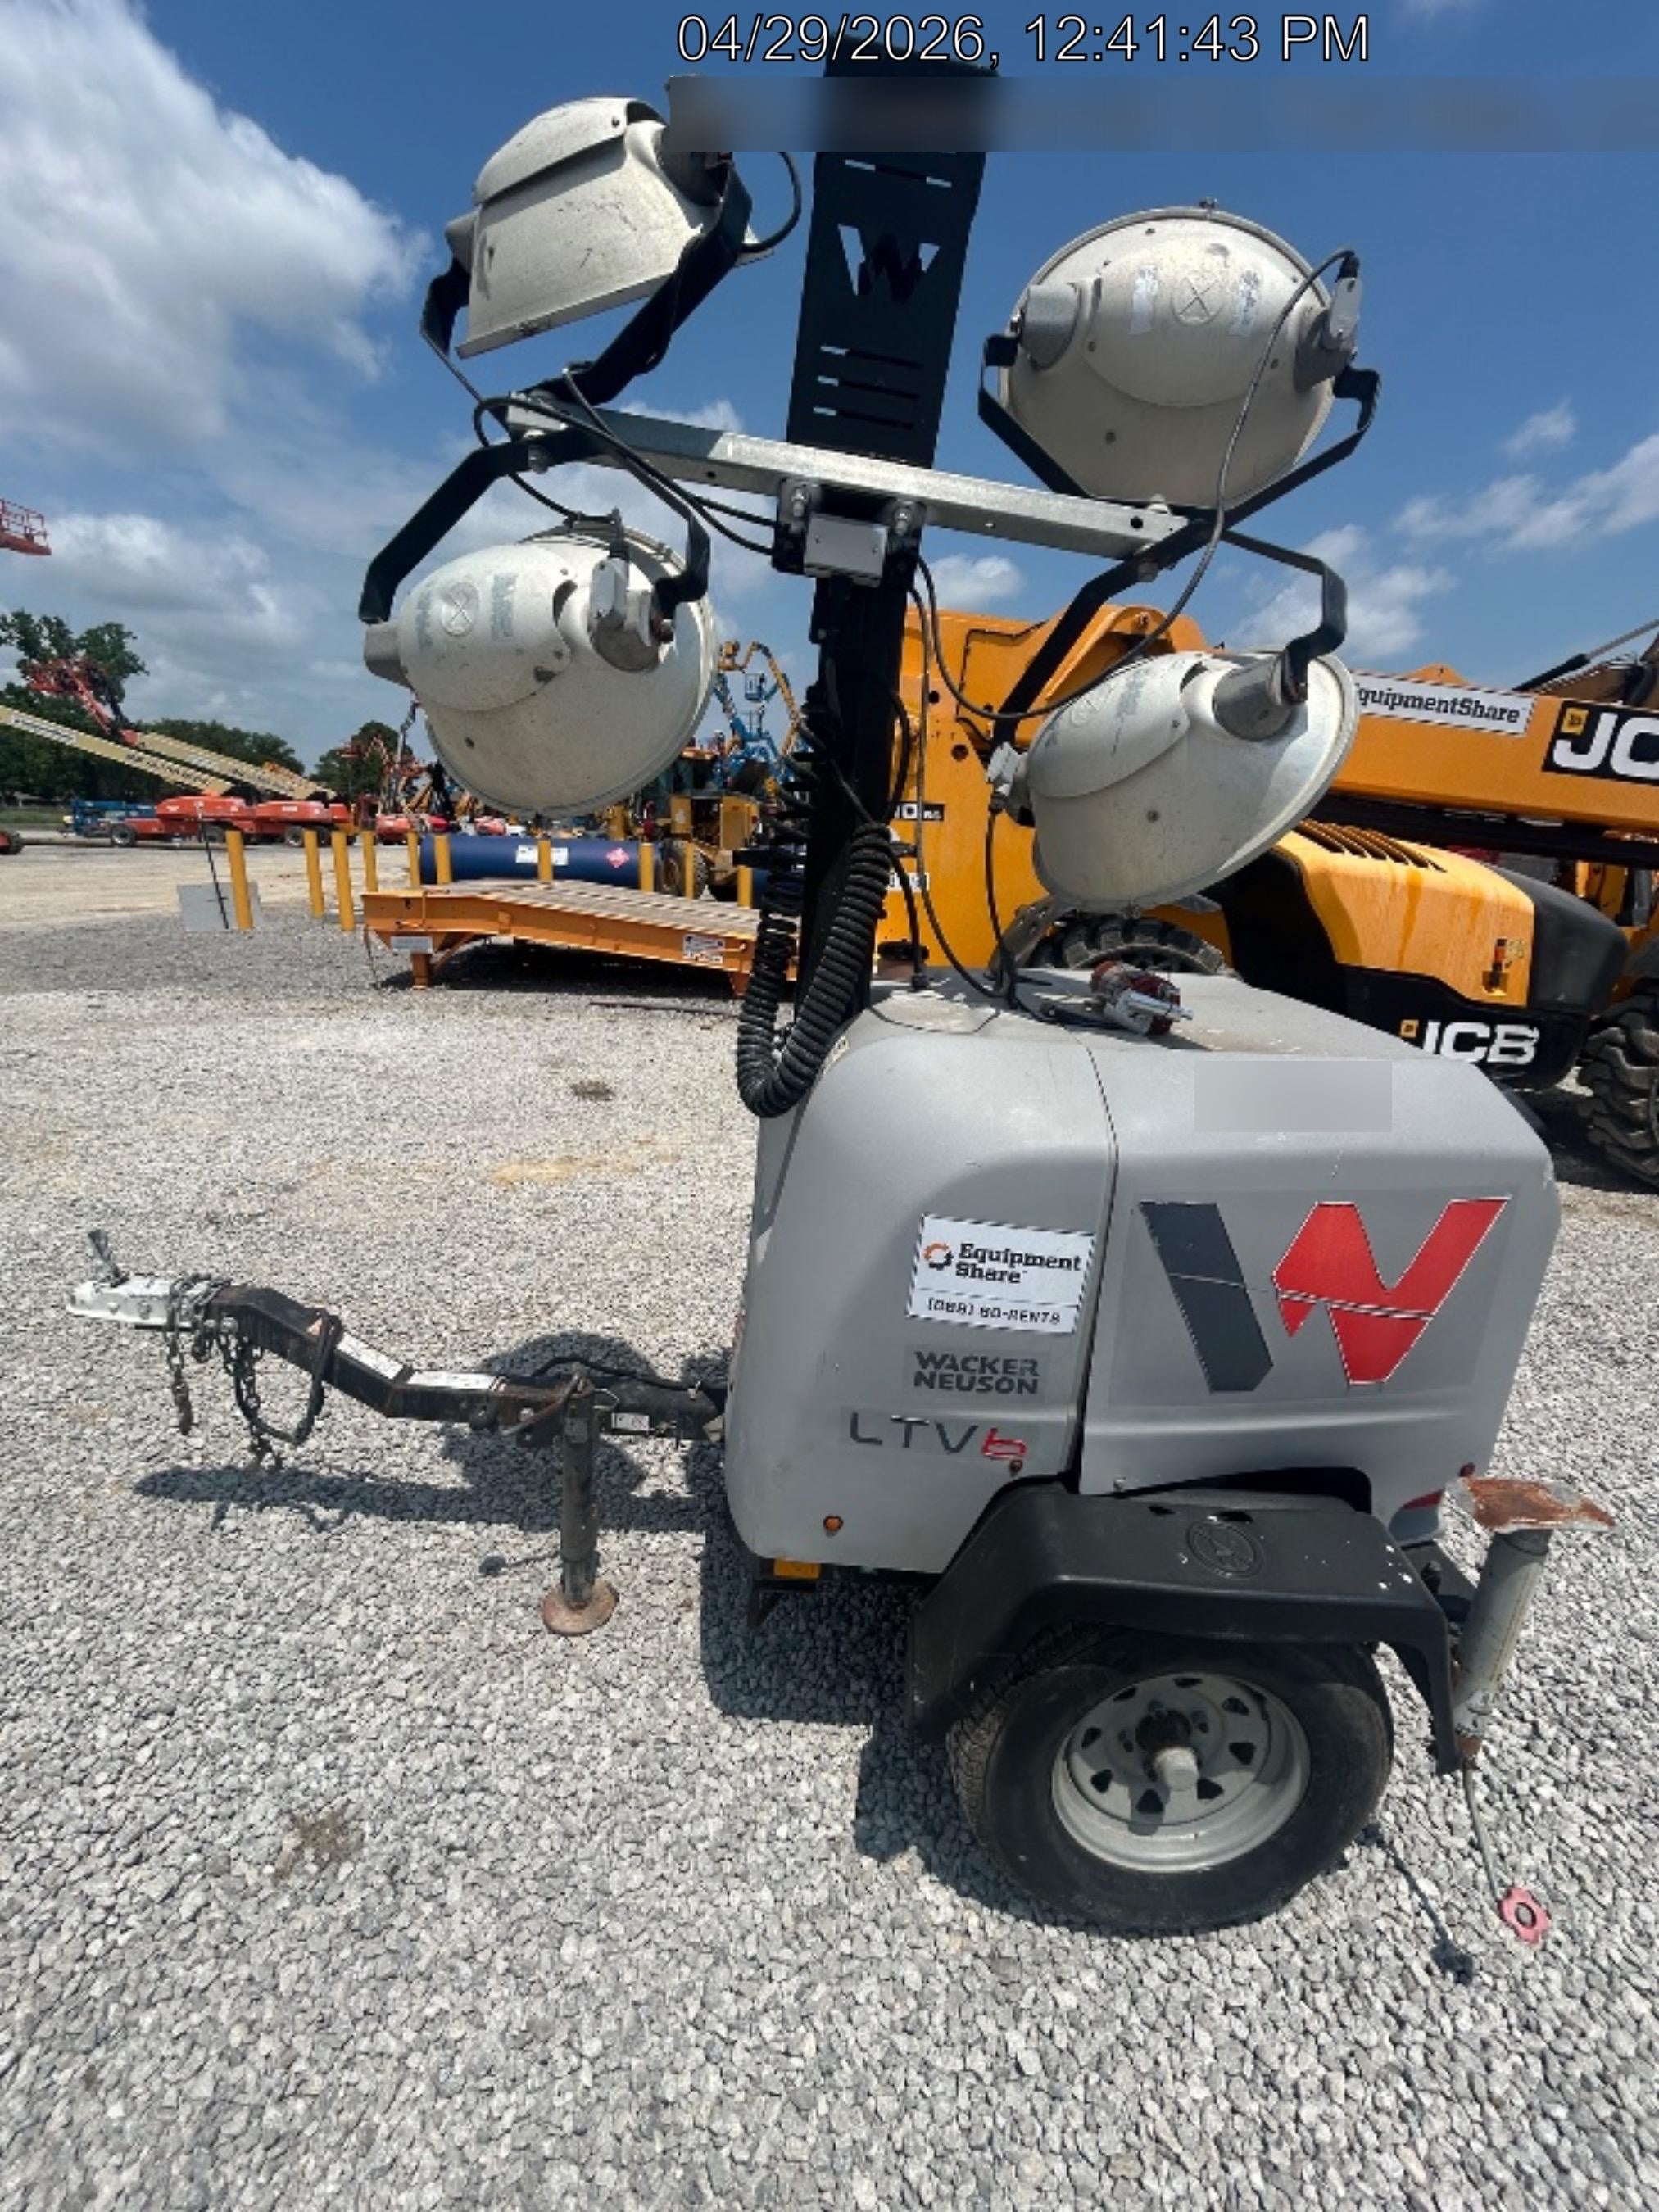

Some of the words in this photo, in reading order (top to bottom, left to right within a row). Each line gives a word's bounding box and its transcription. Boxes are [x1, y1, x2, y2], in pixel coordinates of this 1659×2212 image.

[1356, 682, 1521, 723] quipmentShare
[959, 1243, 1082, 1271] Equipment
[955, 1262, 1022, 1284] Share
[913, 1351, 1040, 1377] WACKER
[913, 1371, 1039, 1394] NEUSON
